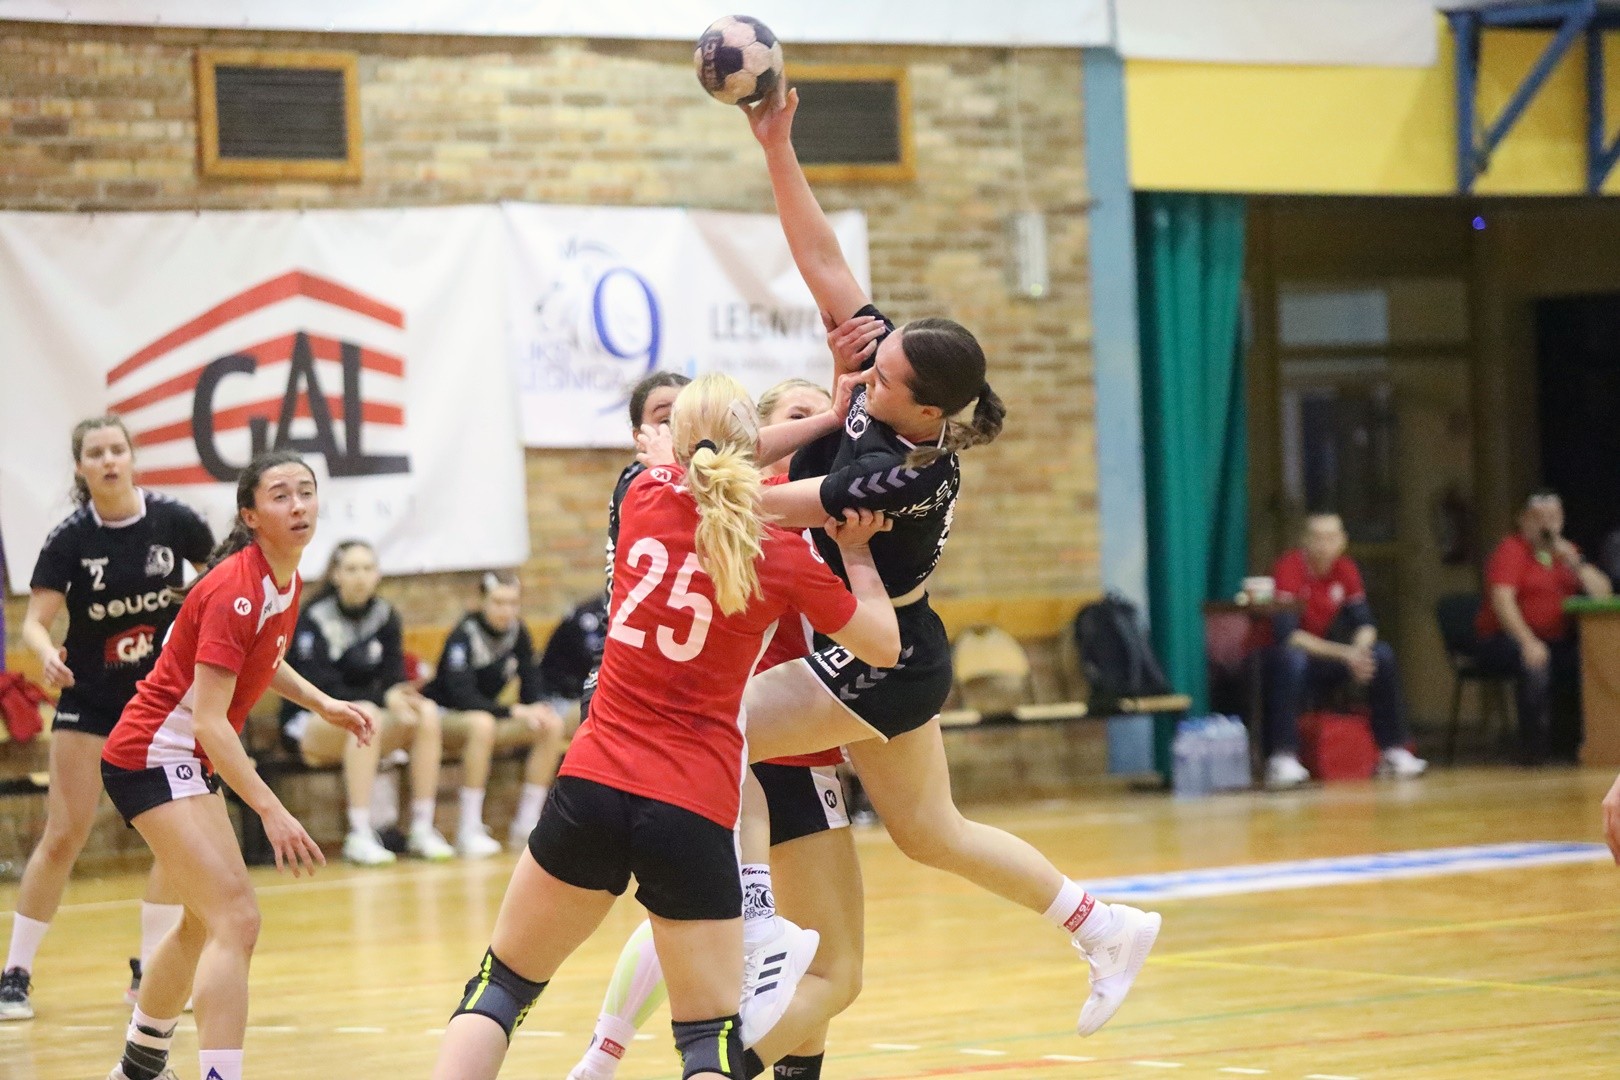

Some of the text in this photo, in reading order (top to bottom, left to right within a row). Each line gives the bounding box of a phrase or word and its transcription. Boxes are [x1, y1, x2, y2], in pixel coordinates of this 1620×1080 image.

[191, 331, 412, 483] GAL
[849, 391, 868, 419] EGNICA
[90, 565, 106, 591] 2
[609, 537, 714, 662] 25
